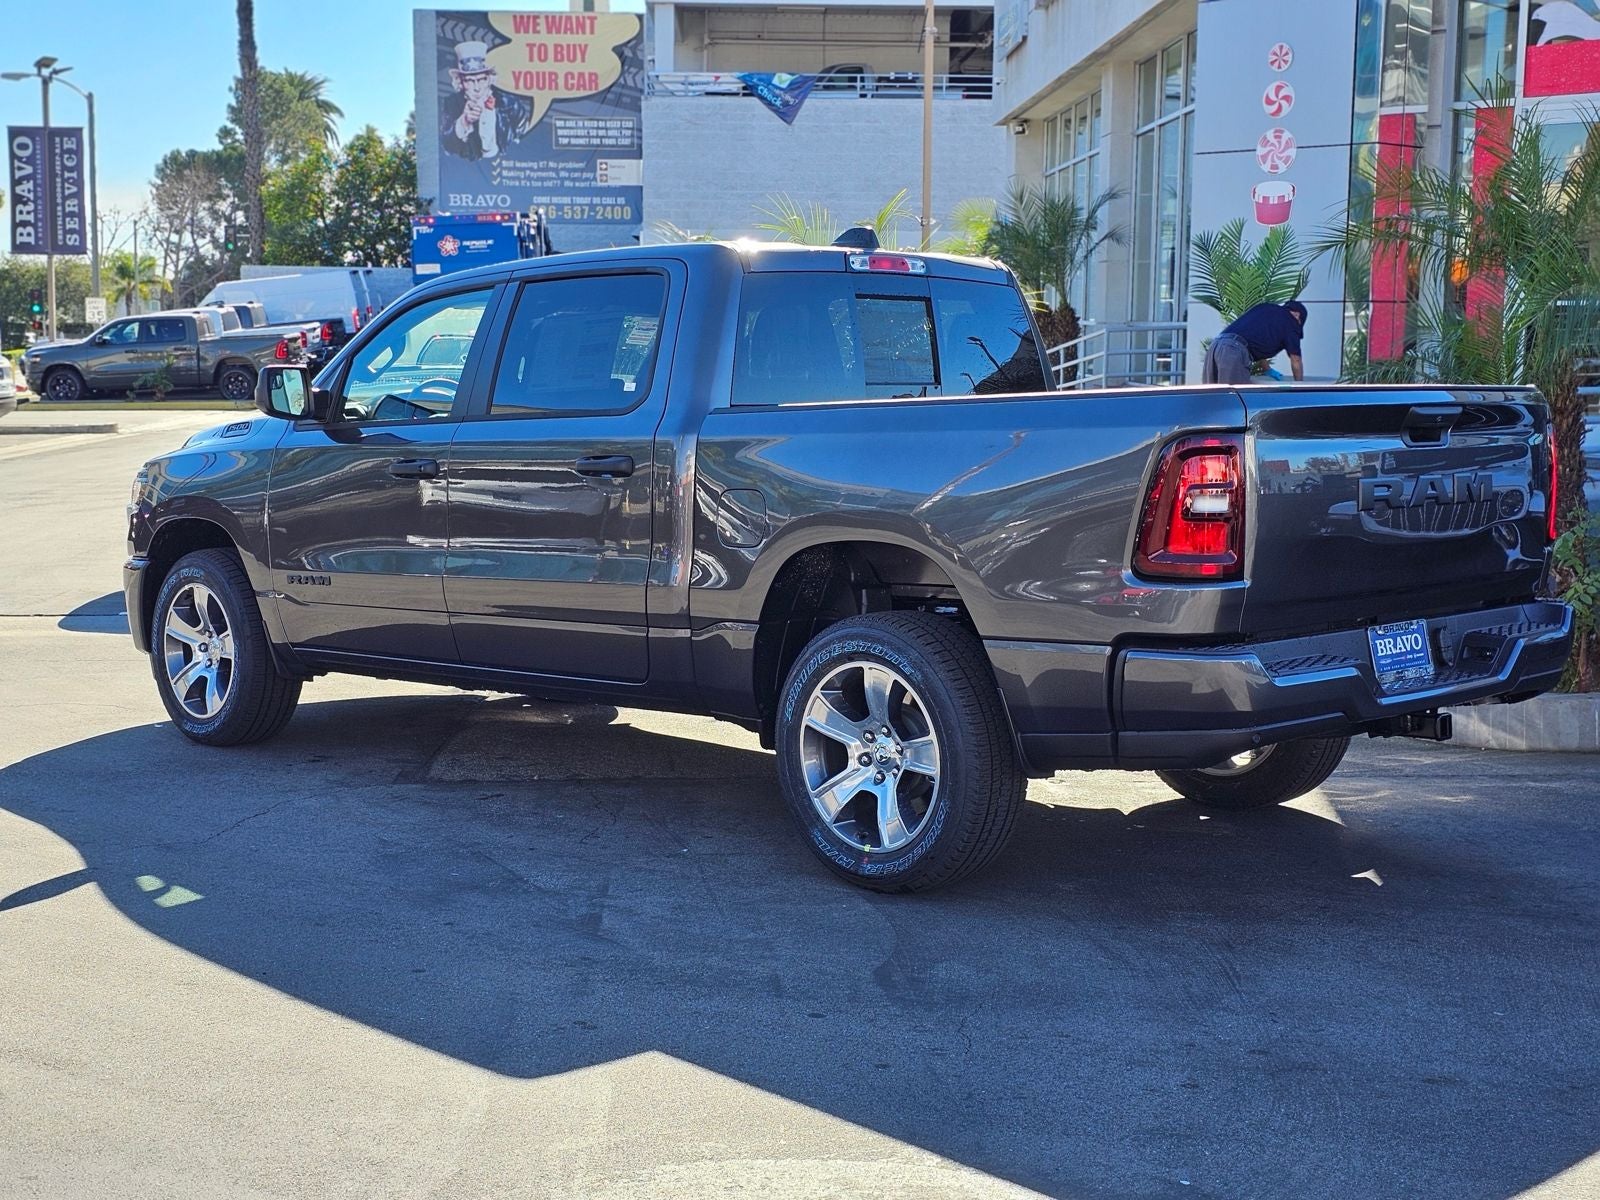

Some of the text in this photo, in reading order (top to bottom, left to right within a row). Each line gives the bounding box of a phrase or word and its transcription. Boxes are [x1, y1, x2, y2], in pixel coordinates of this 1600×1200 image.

[512, 14, 598, 35] WE WANT
[526, 42, 589, 63] TO BUY
[512, 70, 599, 91] YOUR CAR
[502, 170, 524, 178] Making
[13, 136, 35, 245] BRAVO
[63, 137, 80, 246] SERVICE
[448, 194, 511, 208] BRAVO
[88, 310, 104, 320] 35
[1358, 472, 1493, 512] RAM
[1383, 622, 1411, 634] BRAVO
[1375, 634, 1422, 656] BRAVO
[785, 640, 915, 721] BRIDGESTONE
